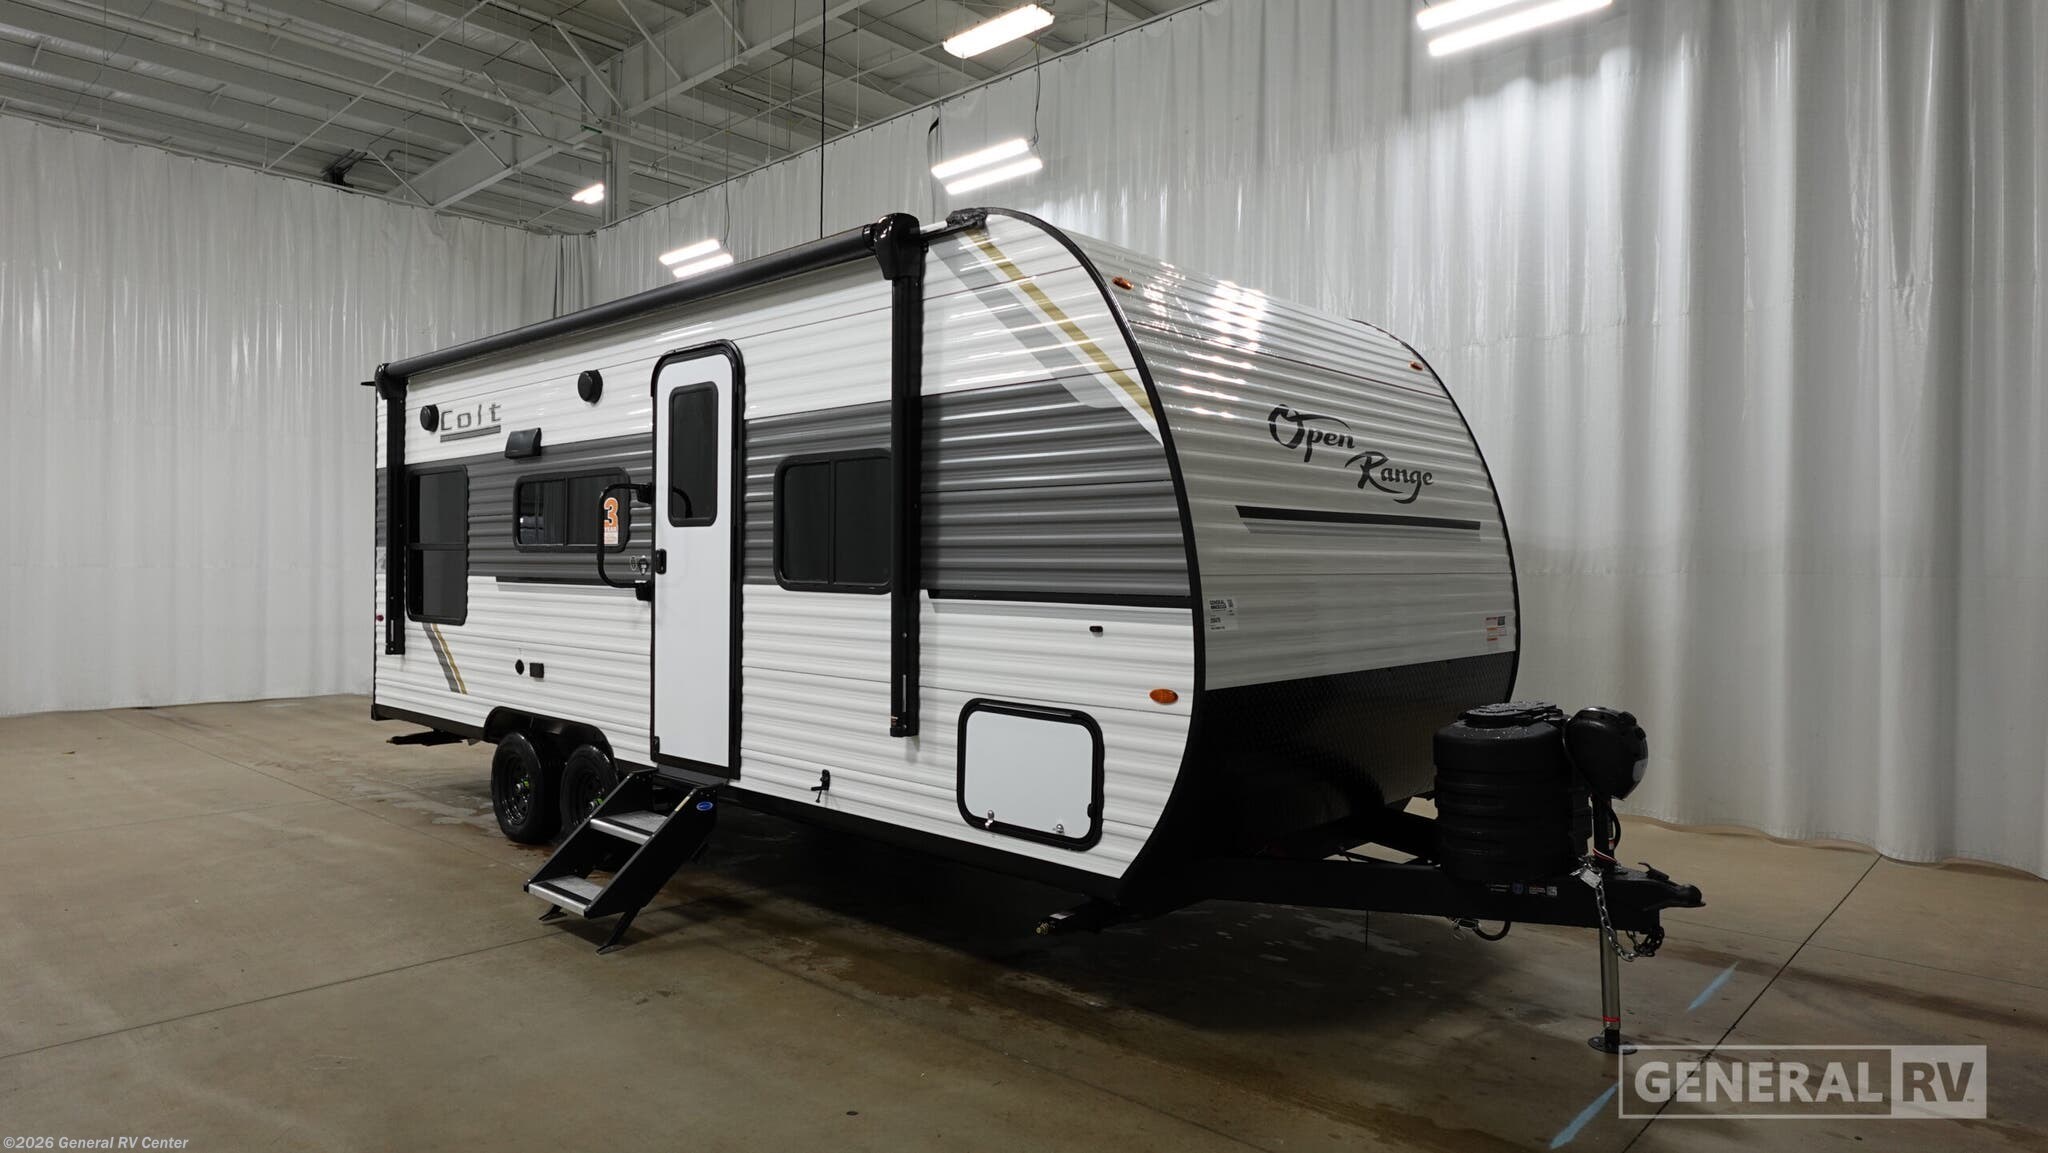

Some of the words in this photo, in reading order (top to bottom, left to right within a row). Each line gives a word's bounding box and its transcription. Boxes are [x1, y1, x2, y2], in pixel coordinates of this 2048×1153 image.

[440, 403, 501, 431] Colt
[1268, 404, 1355, 463] Open
[1344, 451, 1433, 504] Range
[604, 497, 618, 527] 3
